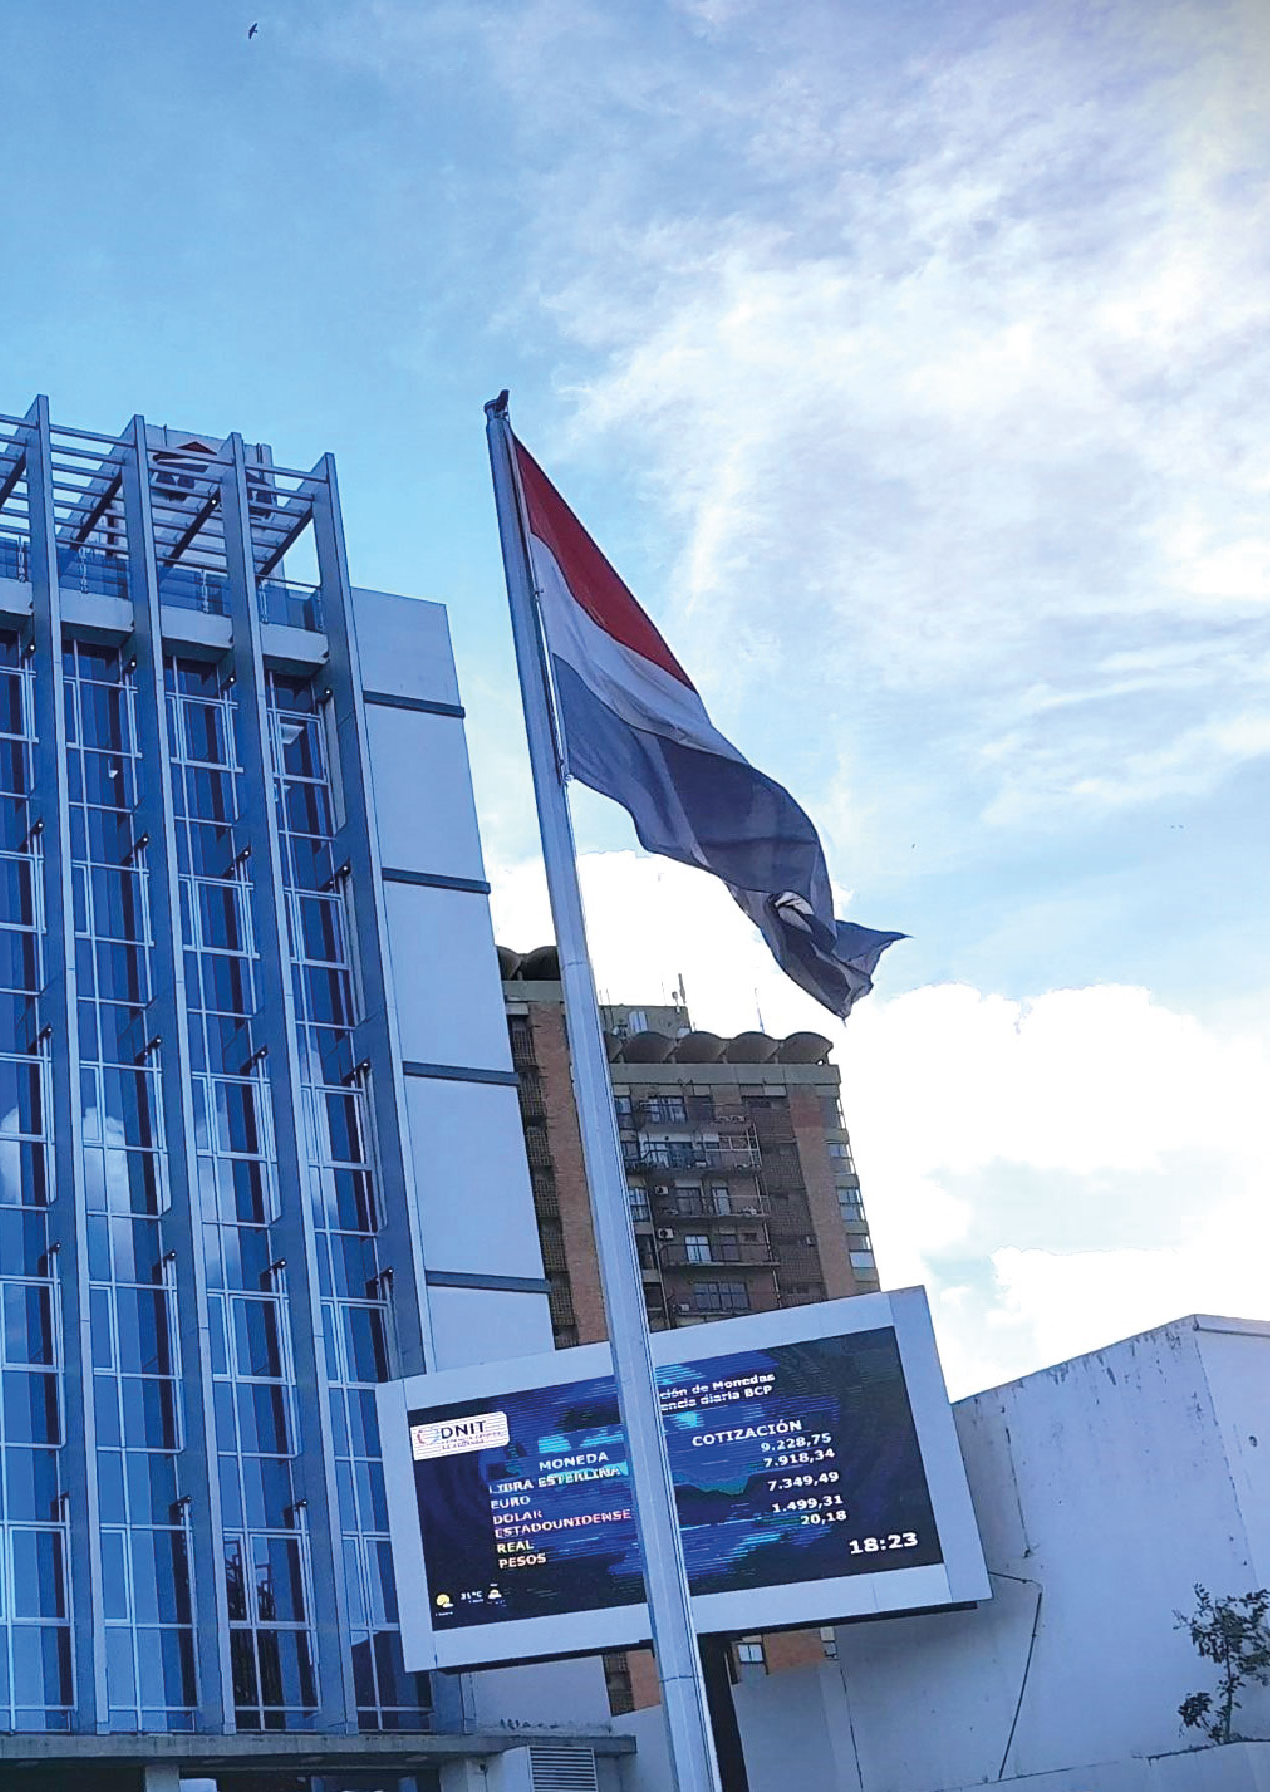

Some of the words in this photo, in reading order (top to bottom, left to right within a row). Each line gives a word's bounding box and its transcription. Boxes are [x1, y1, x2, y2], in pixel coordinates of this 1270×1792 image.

[691, 1384, 709, 1395] de
[712, 1374, 776, 1390] Monedas
[700, 1391, 740, 1405] diaria
[743, 1384, 773, 1399] BCP
[441, 1420, 486, 1440] DNIT
[692, 1418, 802, 1446] COTIZACIÓN
[760, 1432, 832, 1453] 9.228,75
[539, 1451, 610, 1472] MONEDA
[762, 1447, 836, 1468] 7.918,34
[767, 1471, 840, 1492] 7.349,49
[490, 1495, 531, 1510] EURO
[771, 1493, 843, 1513] 1.499,31
[495, 1508, 632, 1539] ESTADOUNIDENSE
[800, 1510, 847, 1525] 20,18
[496, 1539, 535, 1553] REAL
[849, 1531, 919, 1555] 18:23
[499, 1552, 547, 1569] PESOS
